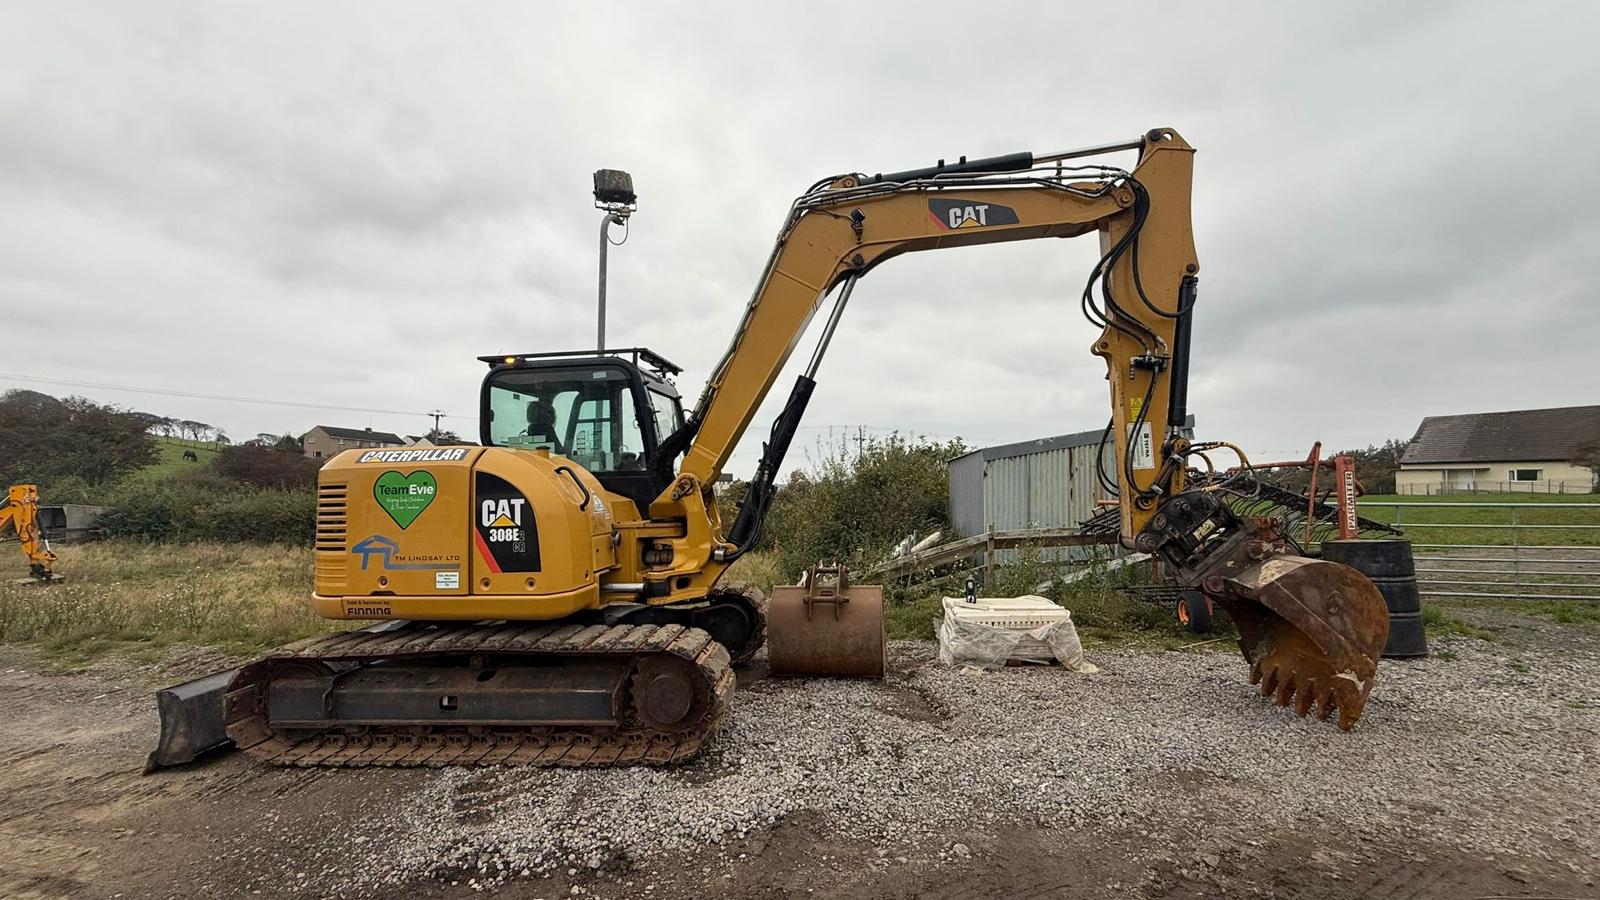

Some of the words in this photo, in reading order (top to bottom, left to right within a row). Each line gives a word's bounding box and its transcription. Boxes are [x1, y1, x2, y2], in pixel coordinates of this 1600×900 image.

[949, 205, 988, 229] CAT
[360, 449, 463, 463] CATERPILLAR
[1346, 472, 1354, 529] PARMITER
[482, 498, 525, 527] CAT
[512, 542, 526, 553] CR
[347, 607, 391, 615] FINNING
